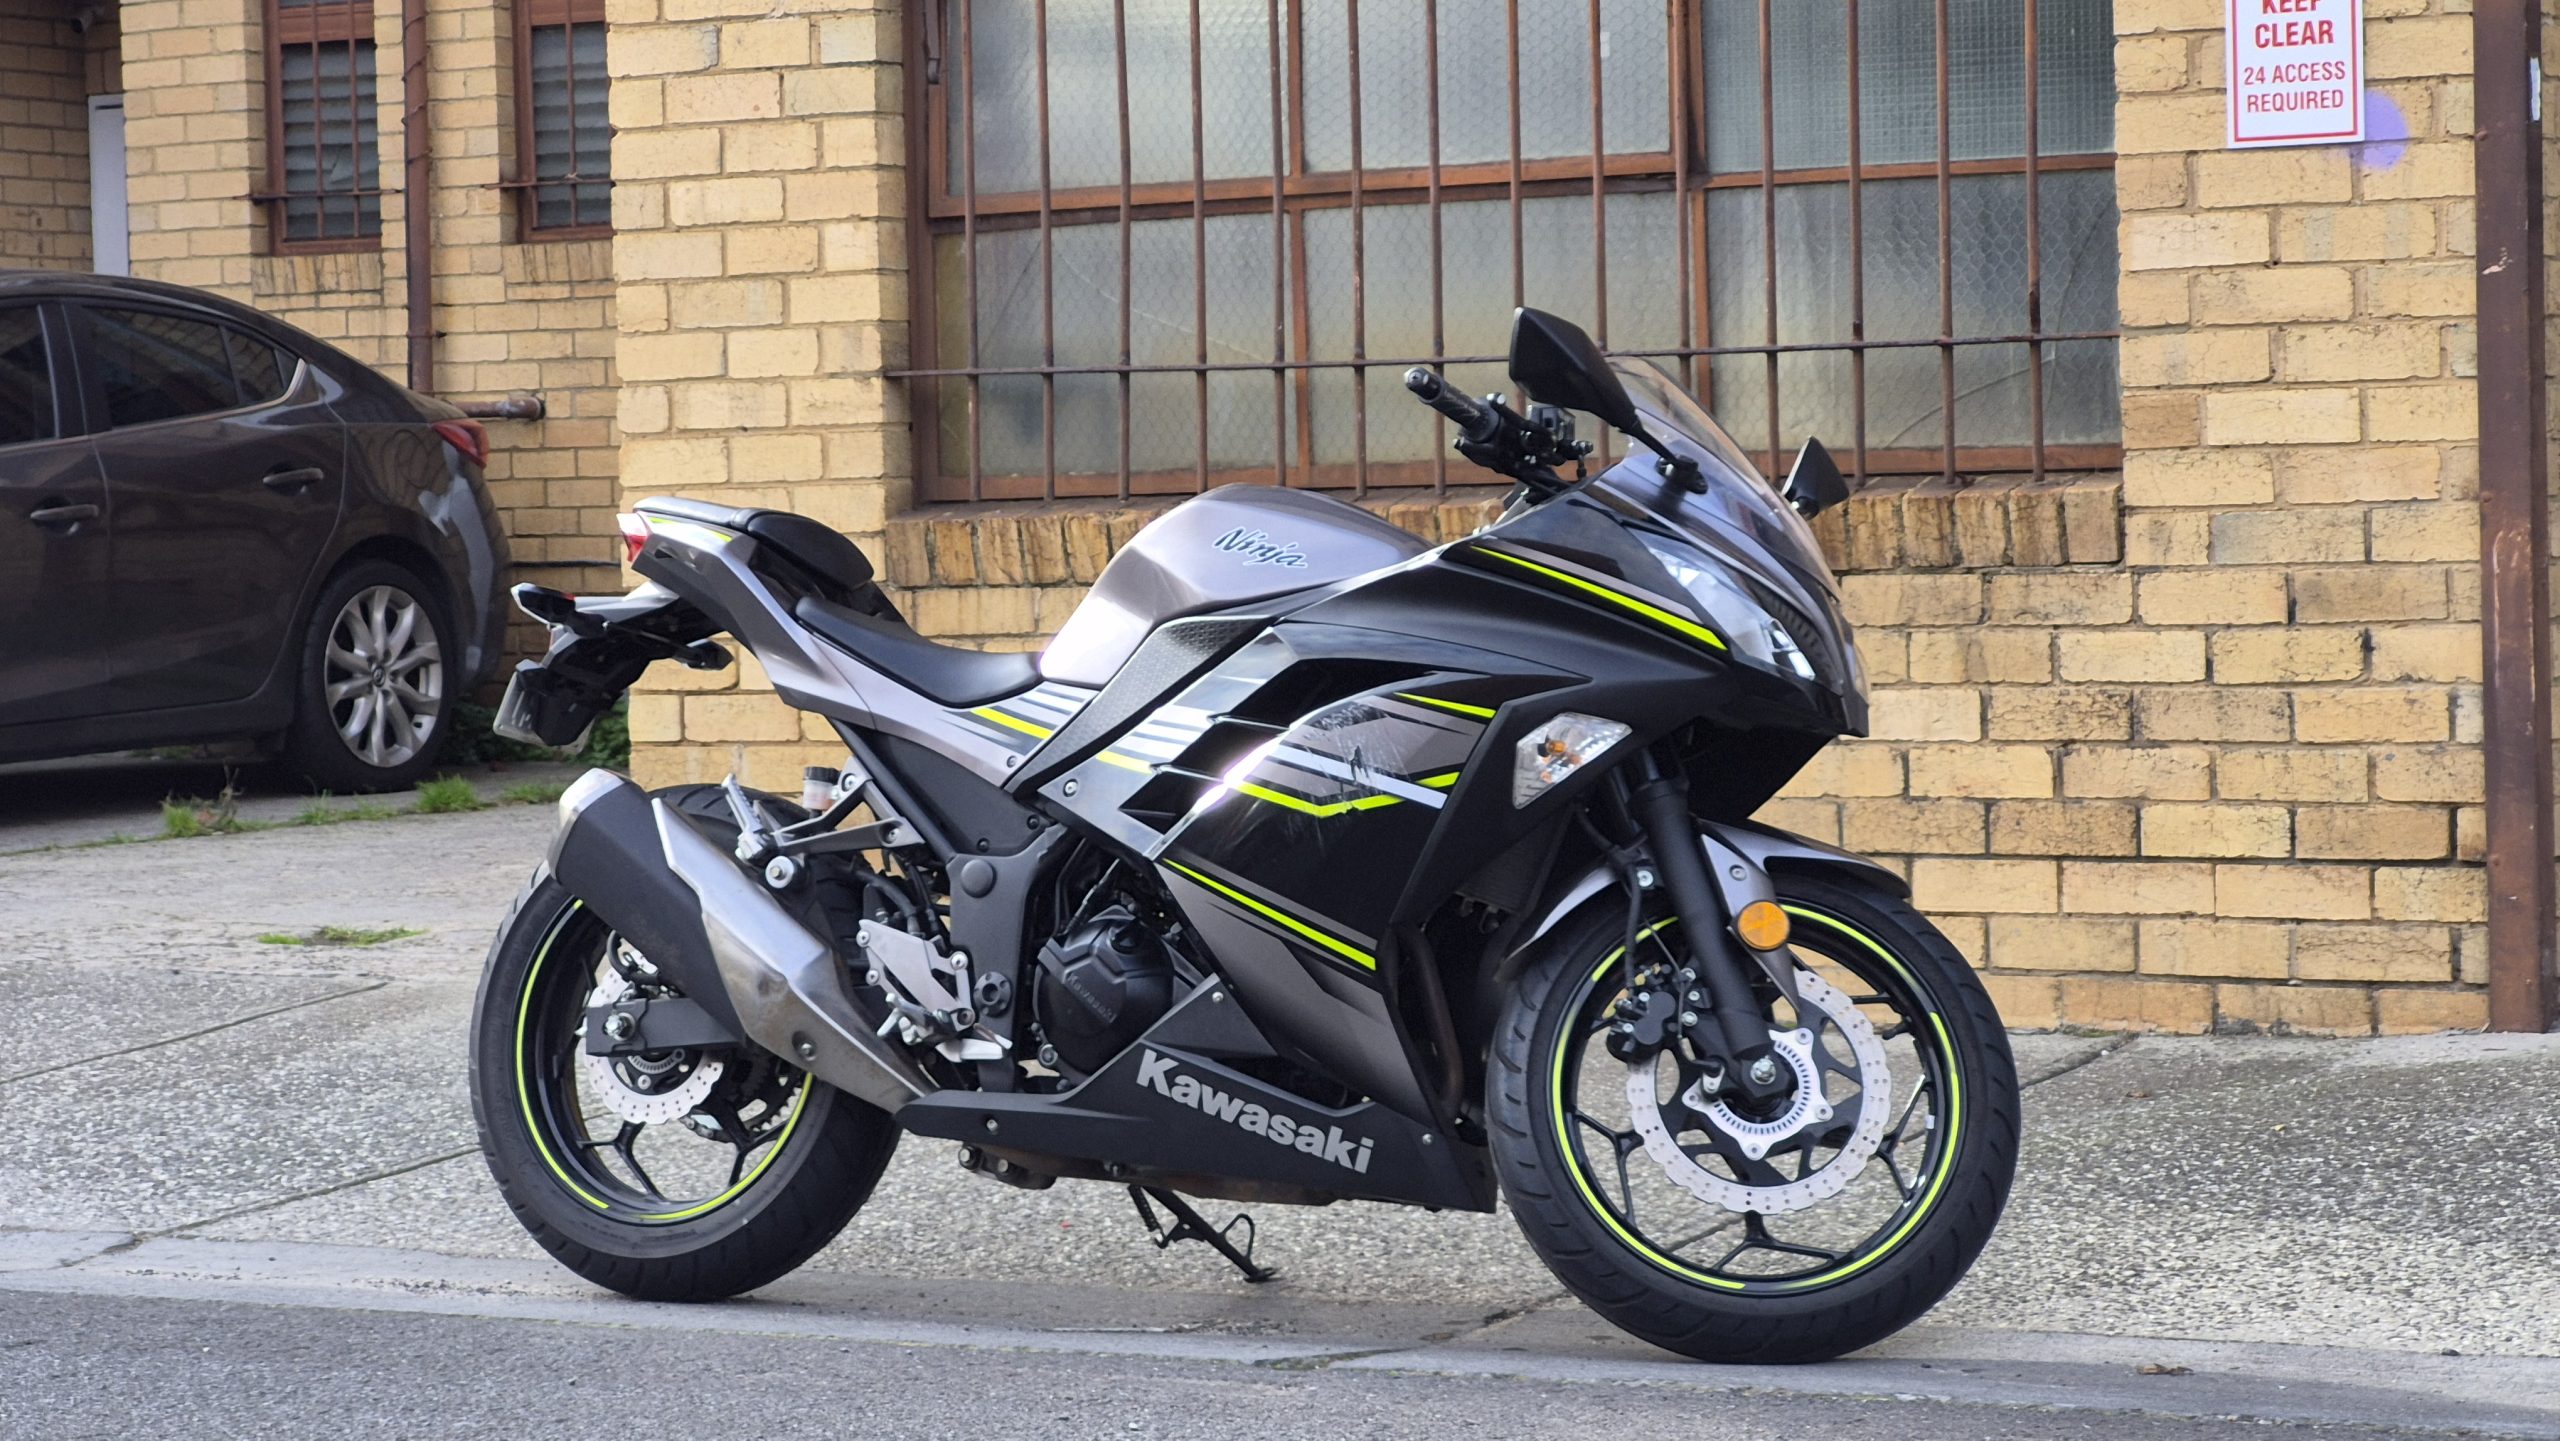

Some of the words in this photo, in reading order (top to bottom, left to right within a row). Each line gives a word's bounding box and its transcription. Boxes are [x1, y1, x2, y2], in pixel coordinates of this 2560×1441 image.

[2255, 20, 2334, 48] CLEAR
[2244, 66, 2265, 85] 24
[2272, 61, 2346, 83] ACCESS
[2247, 90, 2344, 112] REQUIRED
[1212, 526, 1308, 568] Ninja
[1136, 1049, 1375, 1174] Kawasaki
